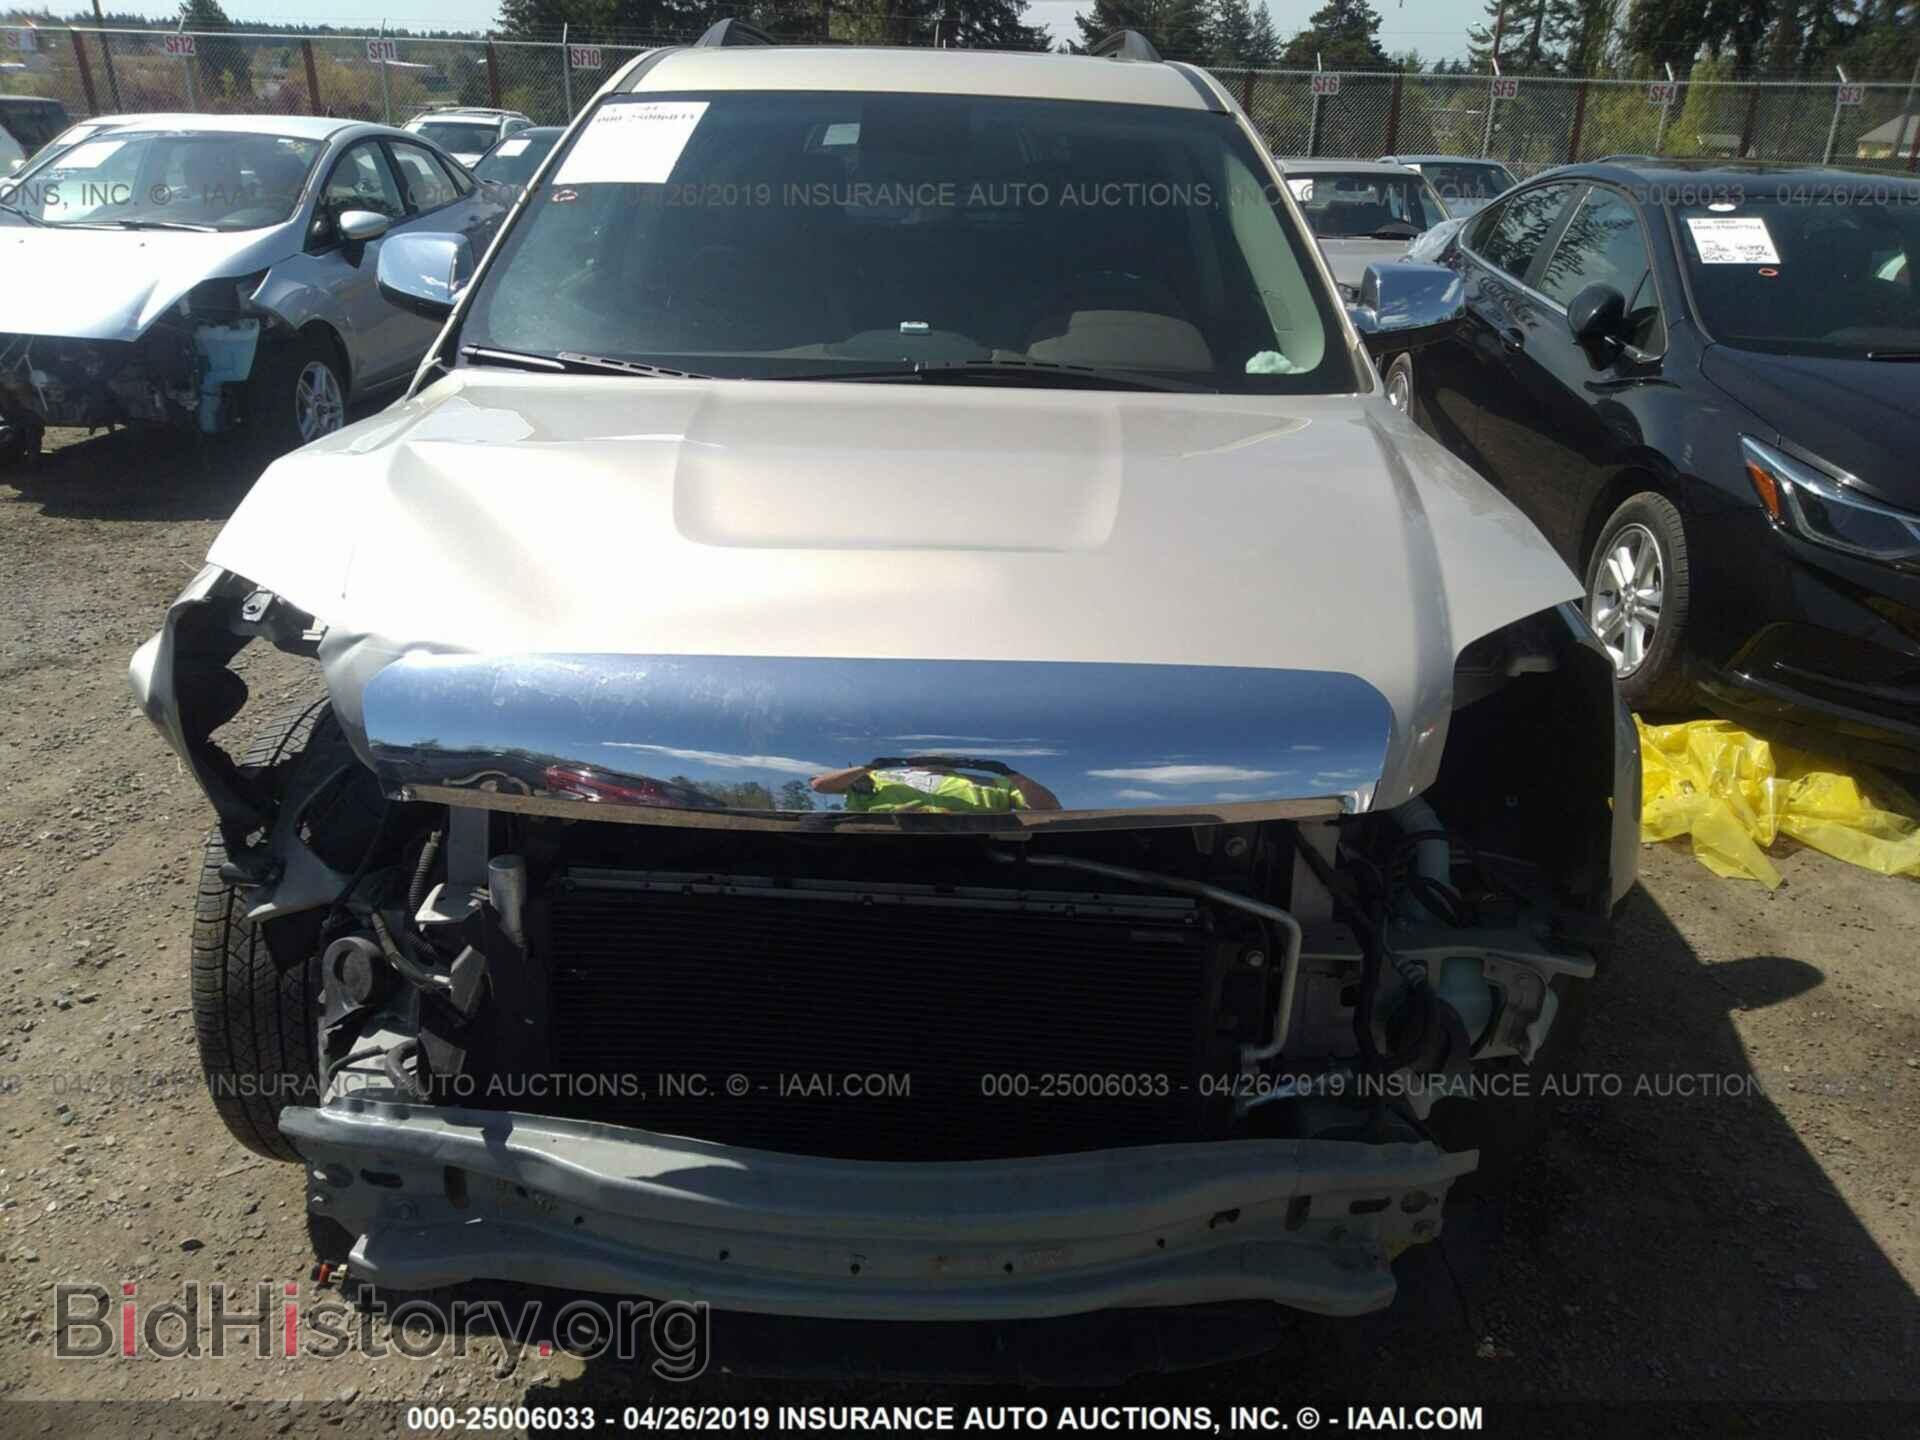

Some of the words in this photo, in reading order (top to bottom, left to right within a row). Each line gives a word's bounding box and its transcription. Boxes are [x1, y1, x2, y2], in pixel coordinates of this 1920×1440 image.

[166, 36, 193, 53] SF12
[369, 42, 396, 59] SF11
[572, 50, 599, 66] SF10
[1313, 76, 1338, 92] SF6
[1493, 80, 1516, 97] SF5
[1651, 86, 1674, 102] SF4
[1839, 86, 1863, 102] SF3
